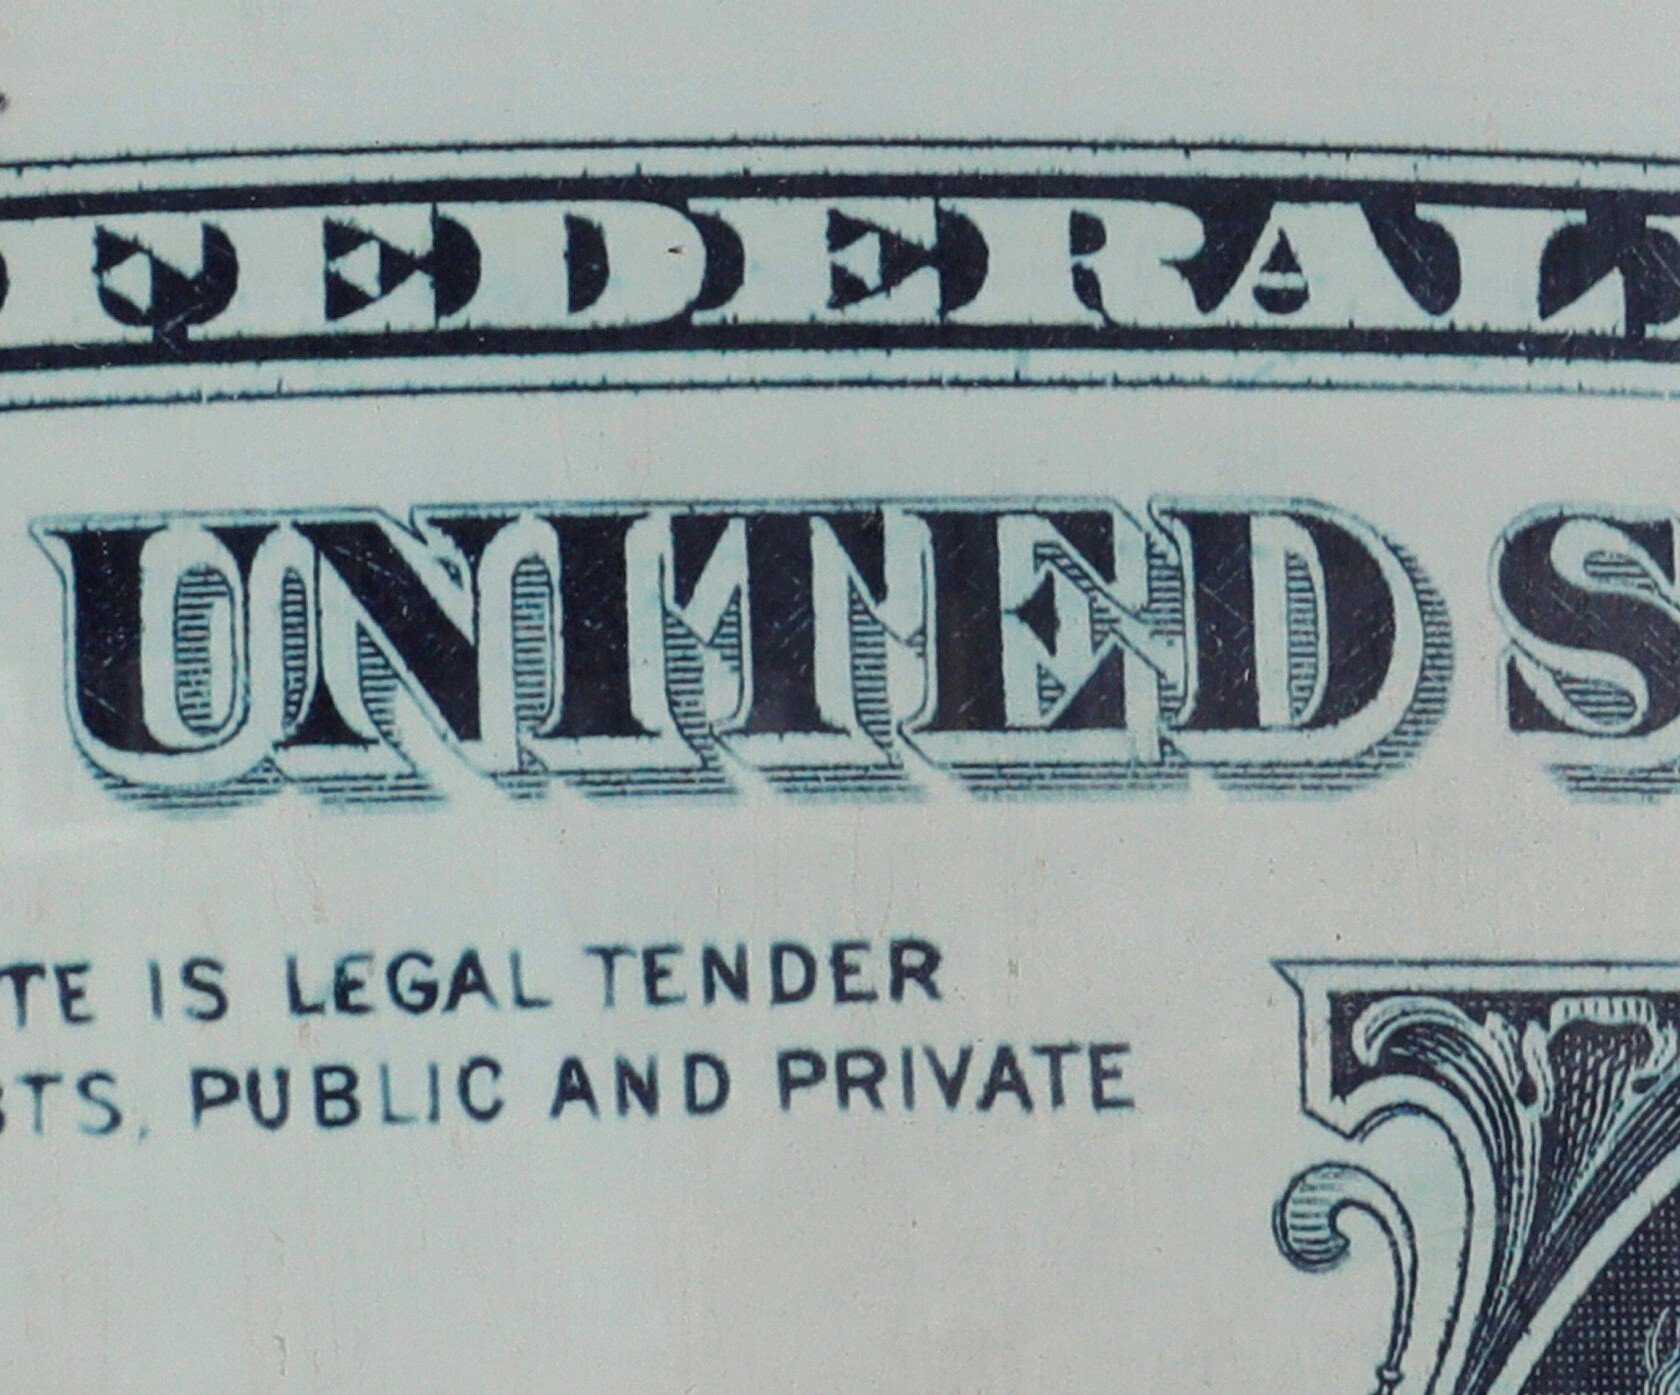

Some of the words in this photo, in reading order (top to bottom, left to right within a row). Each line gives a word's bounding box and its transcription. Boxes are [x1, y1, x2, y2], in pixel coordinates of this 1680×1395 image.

[30, 497, 1454, 812] UNITED
[146, 953, 229, 1023] IS
[284, 946, 554, 1020] LEGAL
[582, 936, 945, 1010] TENDER
[188, 1054, 506, 1132] PUBLIC
[548, 1050, 732, 1120] AND
[775, 1041, 1137, 1116] PRIVATE
